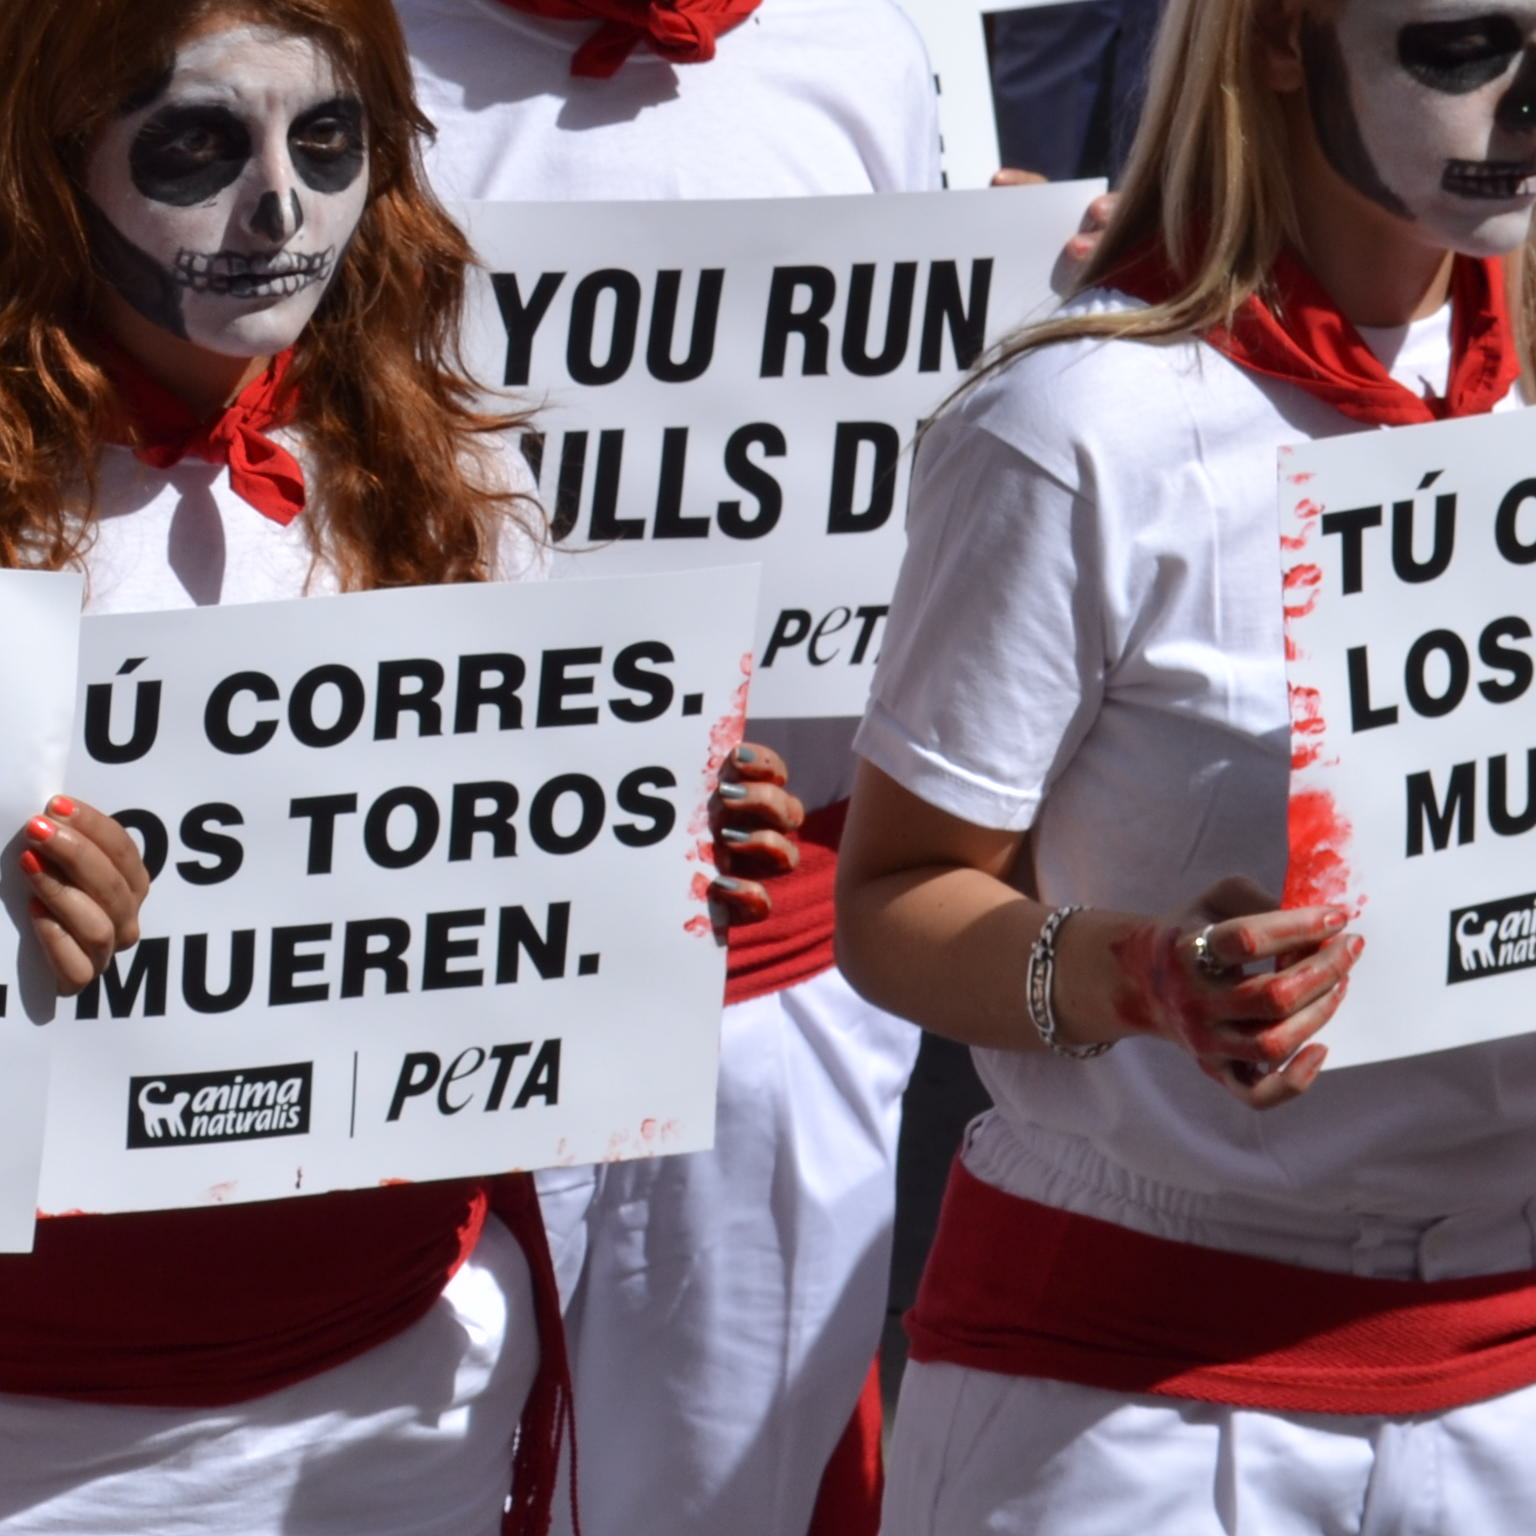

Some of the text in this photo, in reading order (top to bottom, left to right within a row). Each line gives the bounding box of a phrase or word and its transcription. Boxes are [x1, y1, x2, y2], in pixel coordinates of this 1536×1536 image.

[490, 267, 726, 387] YOU
[1321, 469, 1458, 596] TÚ
[202, 639, 705, 755] CORRES.
[1346, 615, 1535, 734] LOS
[288, 765, 678, 876] TOROS
[75, 900, 602, 1021] MUEREN.
[188, 1104, 302, 1139] naturalis
[191, 1074, 304, 1109] anima
